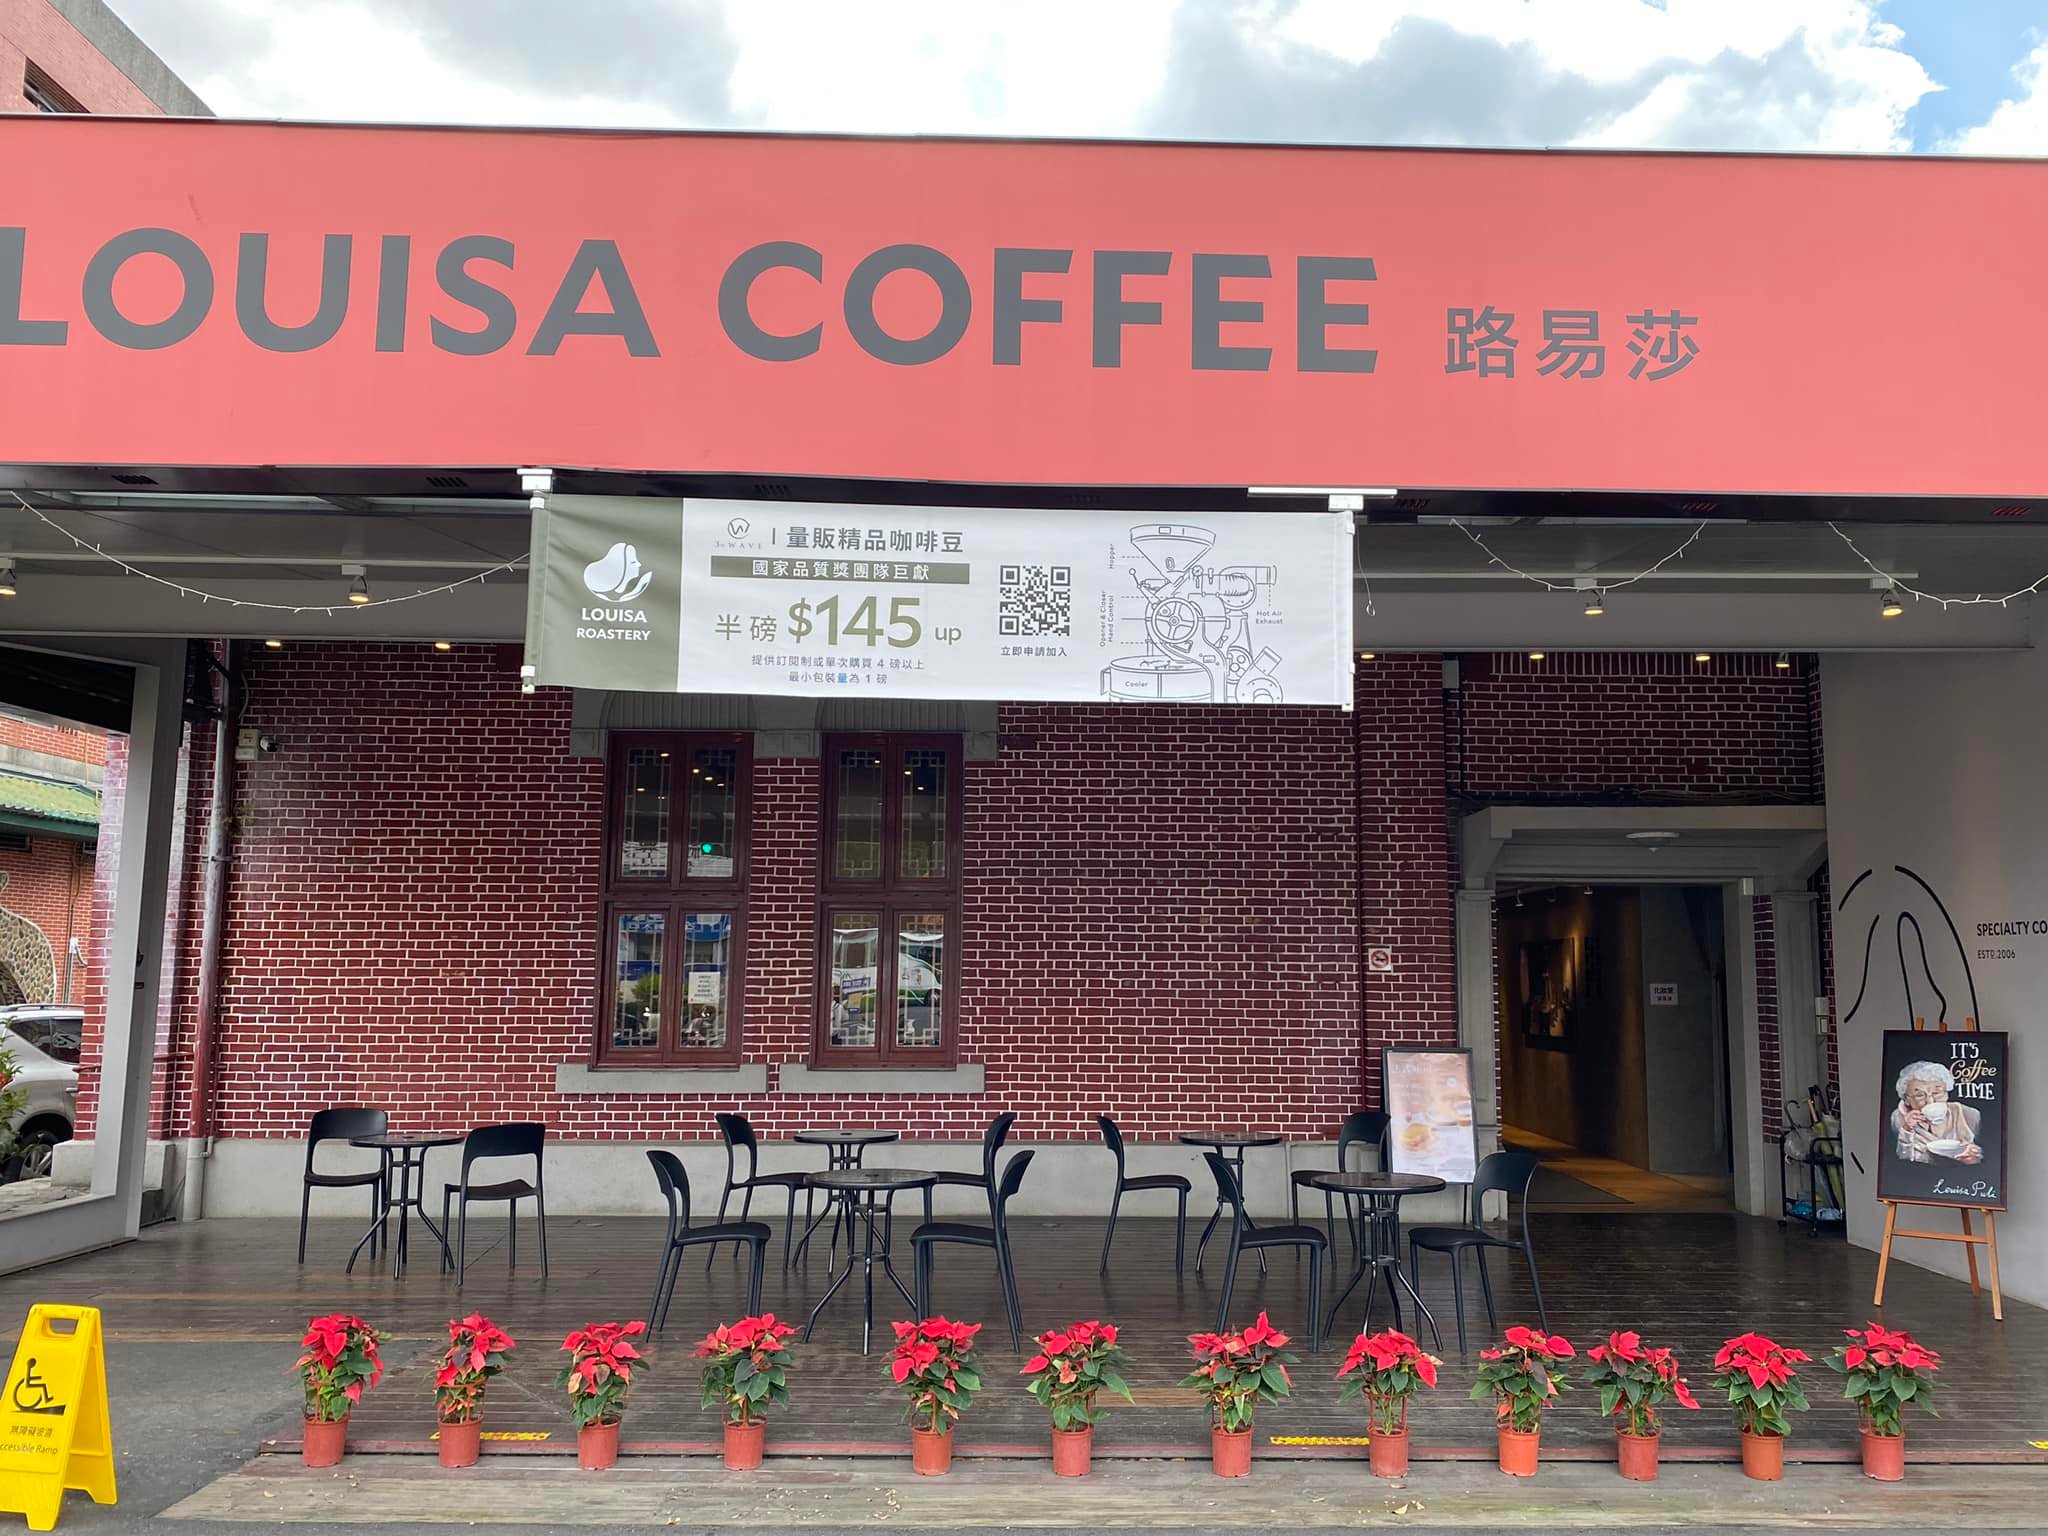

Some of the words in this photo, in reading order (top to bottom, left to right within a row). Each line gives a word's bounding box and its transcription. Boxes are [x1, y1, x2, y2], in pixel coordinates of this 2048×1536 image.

[0, 226, 661, 357] LOUISA
[717, 240, 1379, 373] COFFEE
[1443, 305, 1701, 382] 路易莎
[785, 525, 964, 553] 量販精品咖啡豆
[752, 558, 930, 581] 國家品質獎團隊巨獻
[581, 607, 648, 623] LOUISA
[788, 594, 922, 649] $145
[935, 626, 962, 646] up
[1256, 610, 1270, 618] Hot
[1272, 610, 1283, 618] Air
[576, 627, 652, 641] ROASTERY
[1000, 645, 1068, 657] 立即申請加入
[876, 659, 885, 669] 4
[889, 658, 926, 670] 磅以上
[1976, 921, 2030, 937] SPECIALTY
[1950, 1042, 1980, 1060] IT'S
[1950, 1059, 1998, 1083] Coffee
[1955, 1082, 1996, 1100] TIME
[1933, 1178, 1970, 1196] Louisa
[35, 1444, 58, 1456] Ramp
